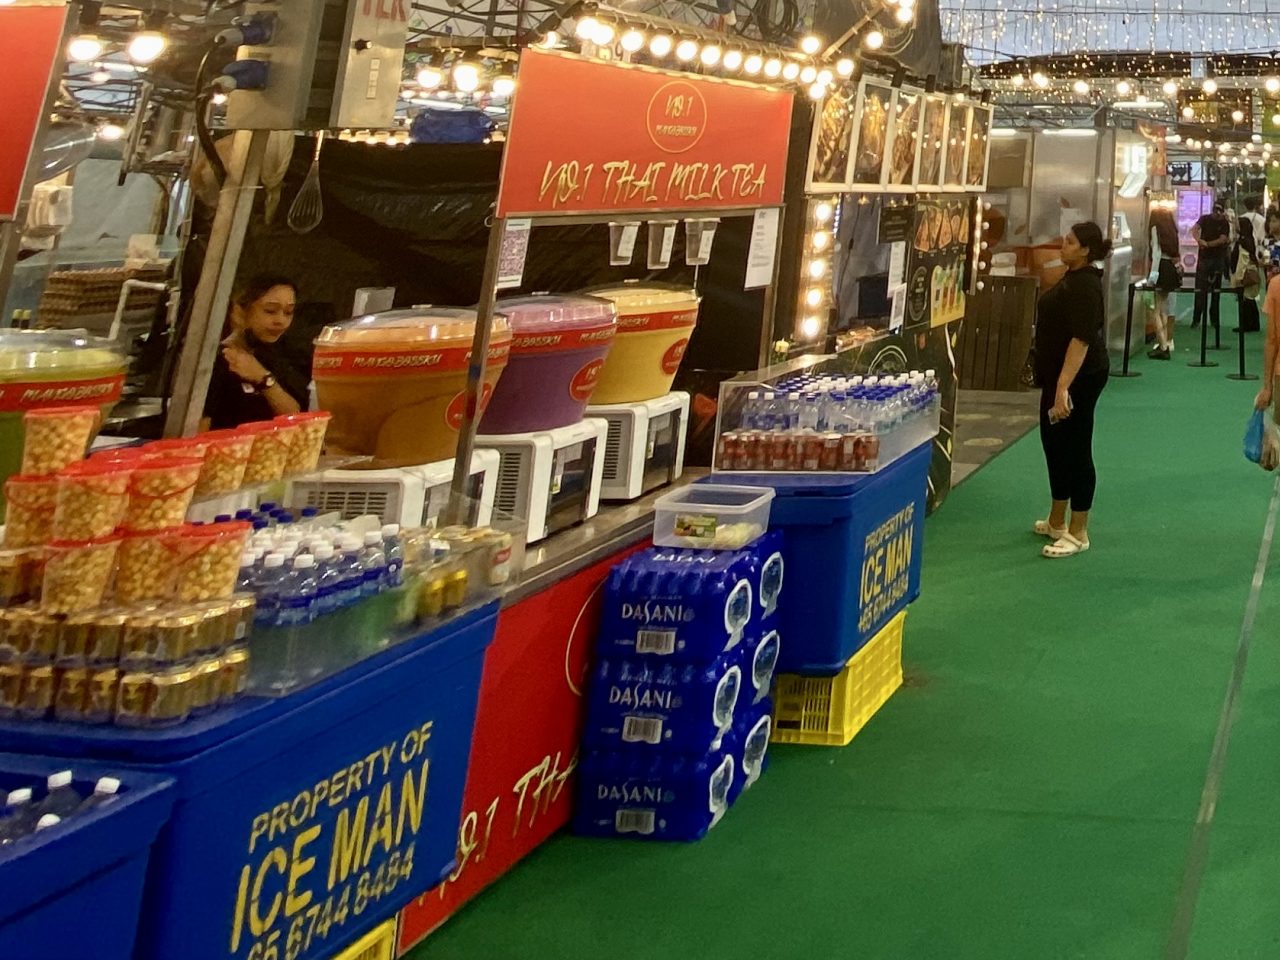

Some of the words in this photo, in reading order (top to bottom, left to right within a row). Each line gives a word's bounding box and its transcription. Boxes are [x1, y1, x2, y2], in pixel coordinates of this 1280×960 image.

[602, 160, 666, 204] THAI
[666, 162, 728, 201] MILK
[731, 162, 767, 199] TEA
[858, 546, 884, 610] ICE
[884, 523, 914, 587] MAN
[622, 600, 683, 624] DASANI
[609, 683, 672, 709] DASANI
[249, 741, 397, 854] PROPERTY
[400, 720, 434, 764] OF
[598, 780, 662, 803] DASANI
[230, 824, 322, 954] ICE
[328, 758, 430, 891] MAN
